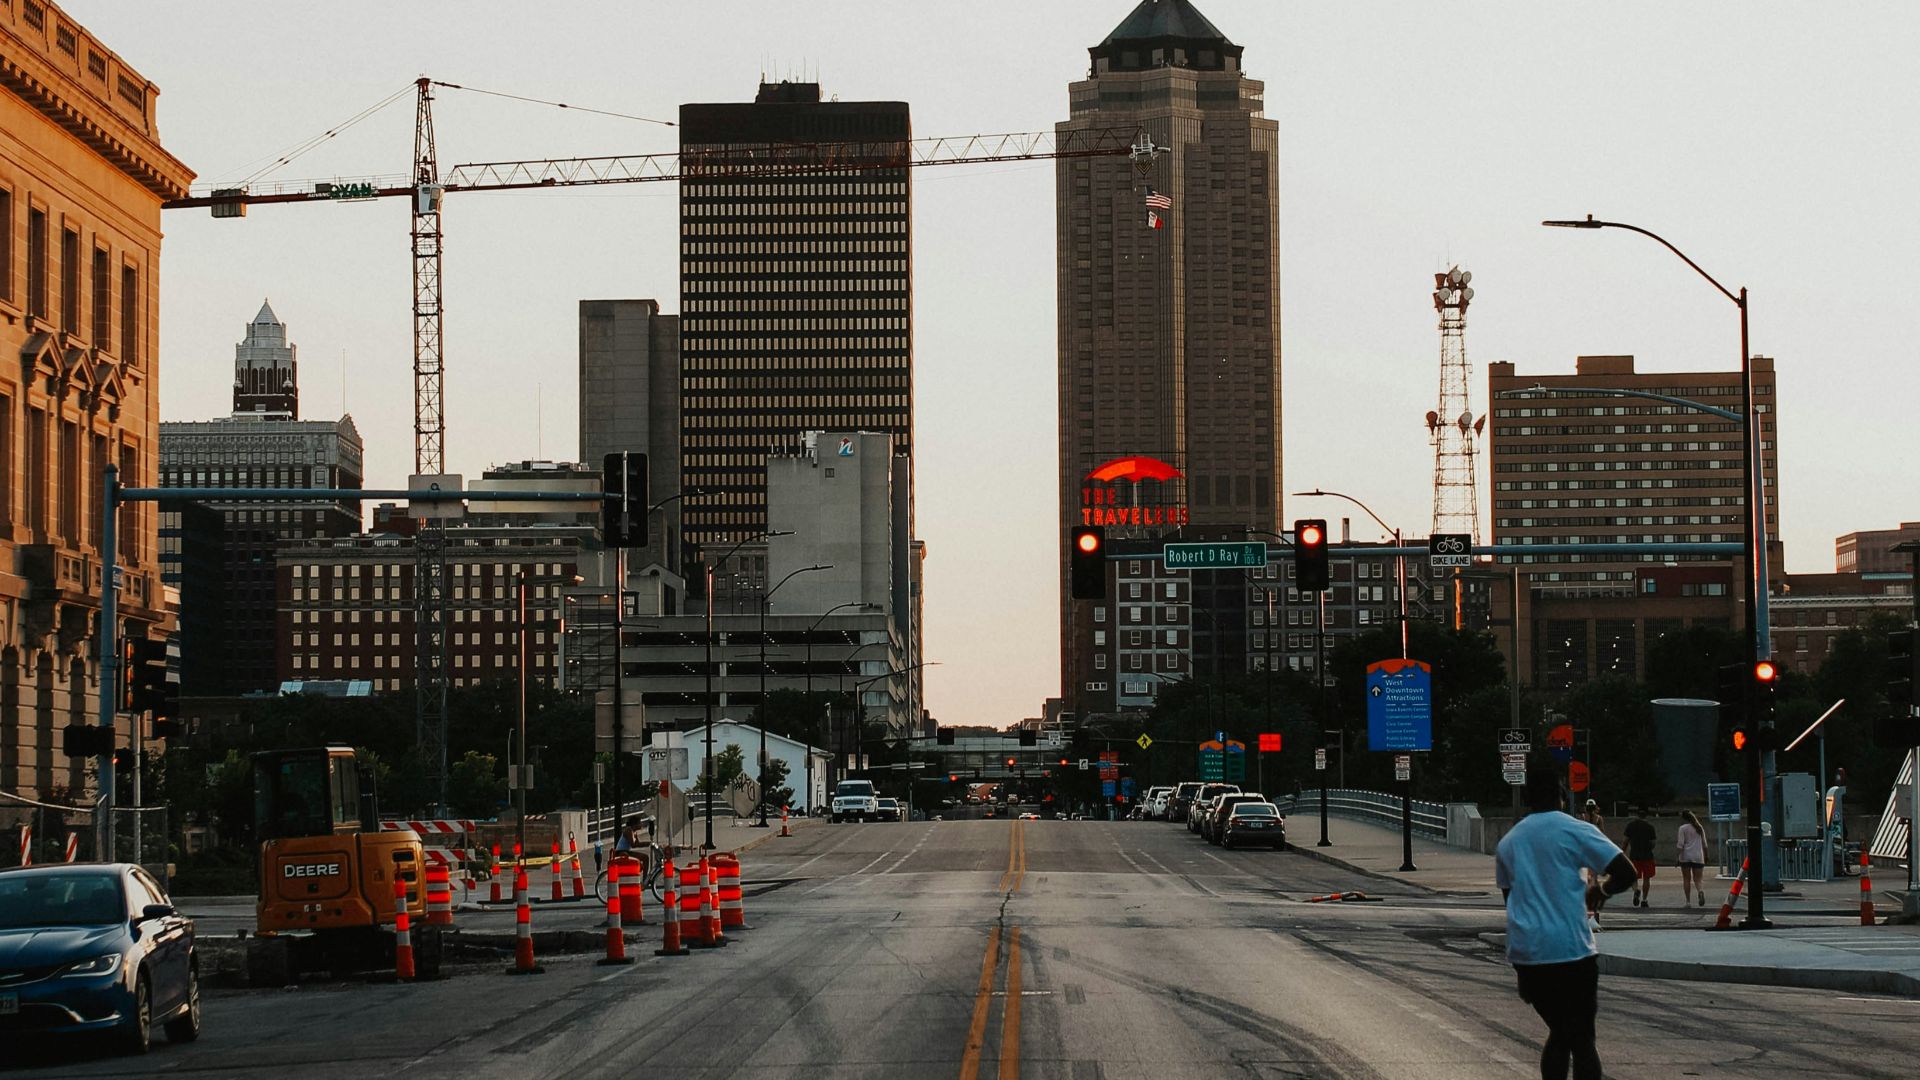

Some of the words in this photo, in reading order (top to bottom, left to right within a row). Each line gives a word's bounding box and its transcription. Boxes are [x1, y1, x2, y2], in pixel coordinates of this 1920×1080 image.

[1082, 488, 1115, 505] THE
[1082, 507, 1189, 525] TRAVELERS
[1169, 549, 1203, 563] Robert
[1209, 549, 1215, 562] D
[1220, 549, 1239, 564] Ray
[1244, 556, 1255, 564] 100
[1433, 556, 1449, 565] BIKE
[1450, 556, 1469, 565] LANE
[284, 864, 339, 877] DEERE
